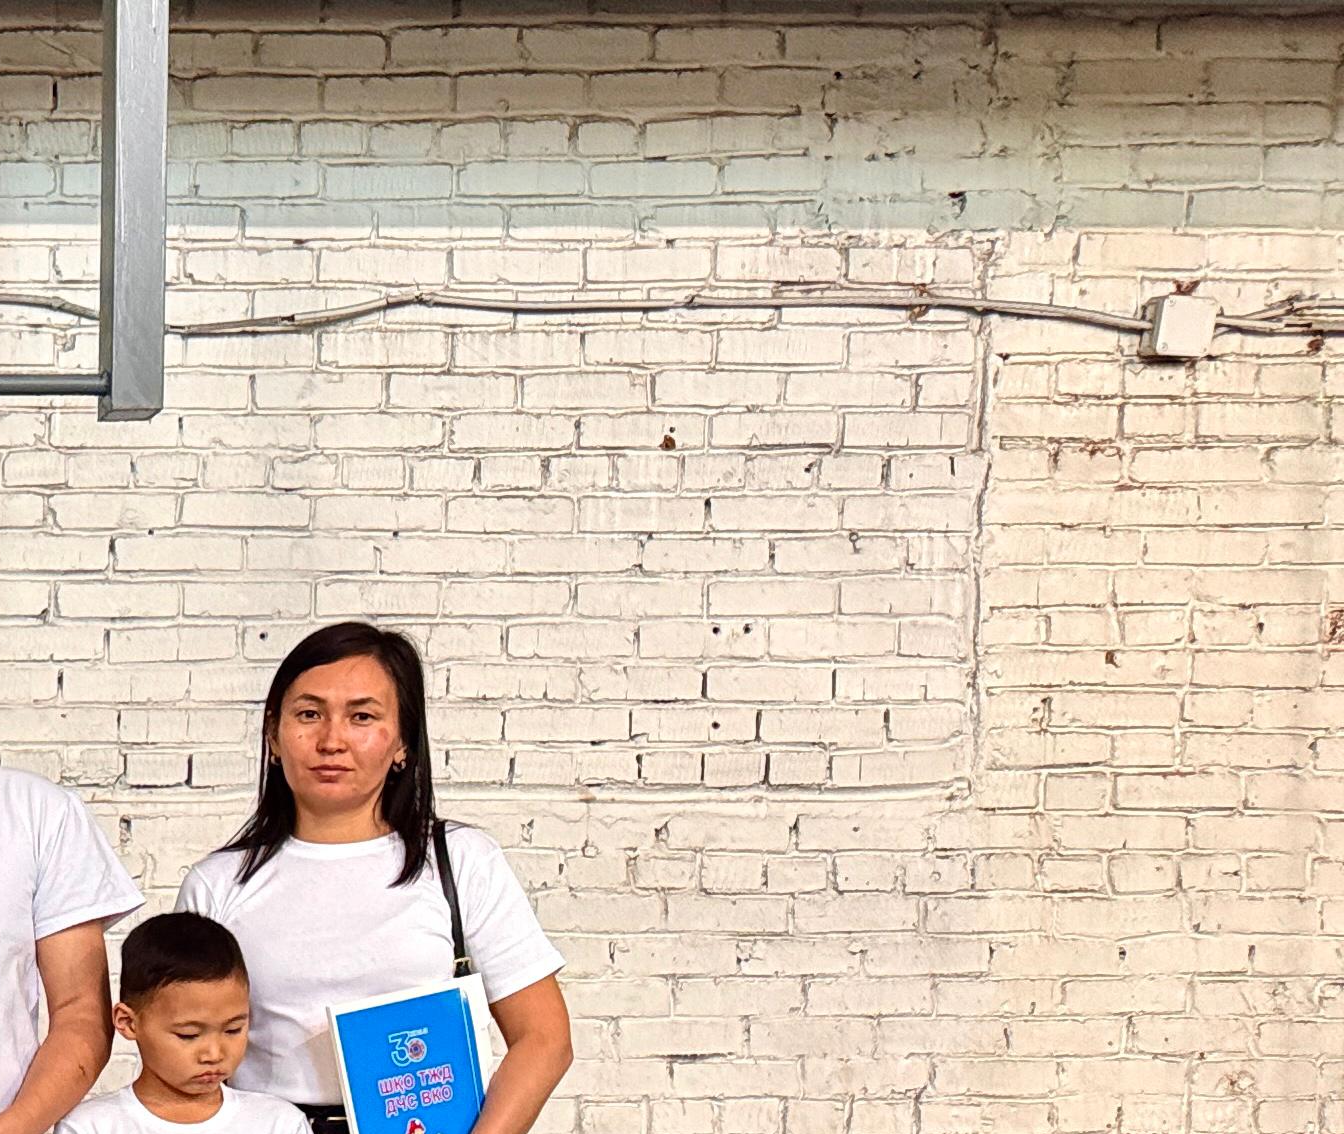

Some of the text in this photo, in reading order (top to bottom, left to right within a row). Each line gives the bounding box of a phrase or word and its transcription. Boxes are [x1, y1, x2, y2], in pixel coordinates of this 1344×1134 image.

[417, 1064, 454, 1086] ТЖД
[385, 1085, 453, 1118] ДЧС ВКО
